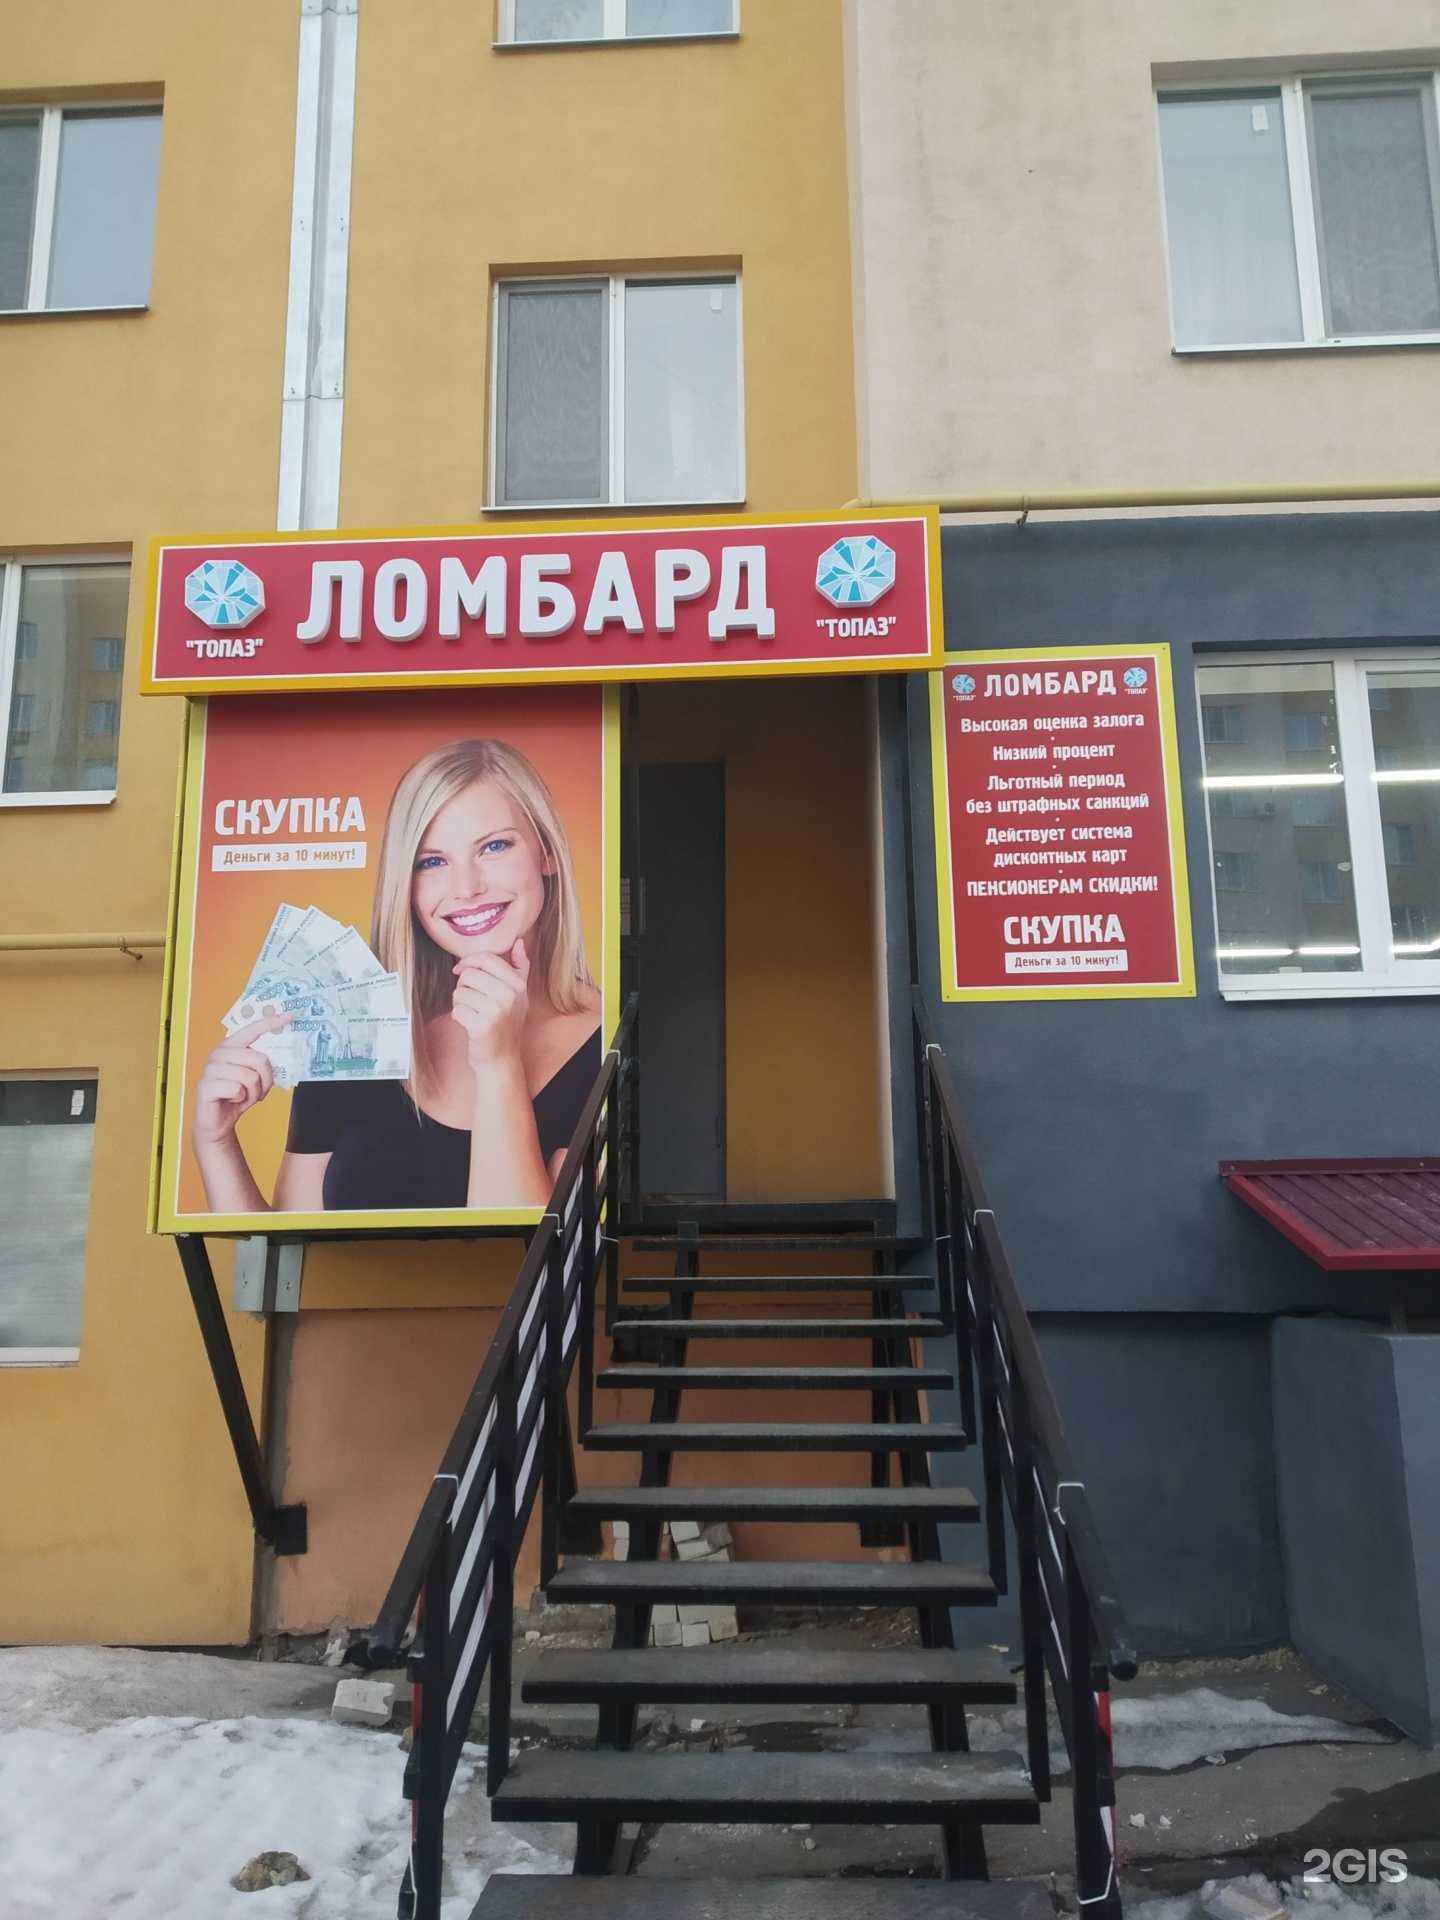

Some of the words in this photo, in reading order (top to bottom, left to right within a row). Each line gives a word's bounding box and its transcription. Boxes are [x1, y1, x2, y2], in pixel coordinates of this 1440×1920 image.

[297, 545, 775, 643] ЛОМБАРД
[816, 616, 896, 637] "ТОПАЗ"
[186, 638, 263, 658] "ТОПАЗ"
[984, 670, 1117, 697] ЛОМБАРД
[961, 717, 1027, 733] Высокая
[1033, 715, 1088, 731] оценка
[1093, 714, 1145, 728] залога
[993, 744, 1047, 761] Низкий
[1053, 744, 1115, 760] процент
[987, 774, 1063, 791] Льготный
[1069, 773, 1125, 789] период
[966, 799, 992, 814] без
[998, 797, 1080, 815] штрафных
[1086, 793, 1149, 810] санкций
[215, 796, 366, 836] СКУПКА
[985, 827, 1066, 845] Действует
[1072, 825, 1133, 841] система
[223, 851, 270, 865] Деньги
[275, 851, 289, 862] за
[295, 849, 308, 862] 10
[313, 848, 356, 862] минут!
[993, 851, 1086, 868] дисконтных
[1092, 849, 1127, 865] карт
[967, 878, 1083, 896] ПЕНСИОНЕРАМ
[1089, 876, 1158, 894] СКИДКИ!
[1003, 914, 1125, 946] СКУПКА
[1015, 956, 1052, 968] Деньги
[1055, 956, 1066, 966] за
[1071, 955, 1081, 966] 10
[1084, 955, 1119, 967] минут!
